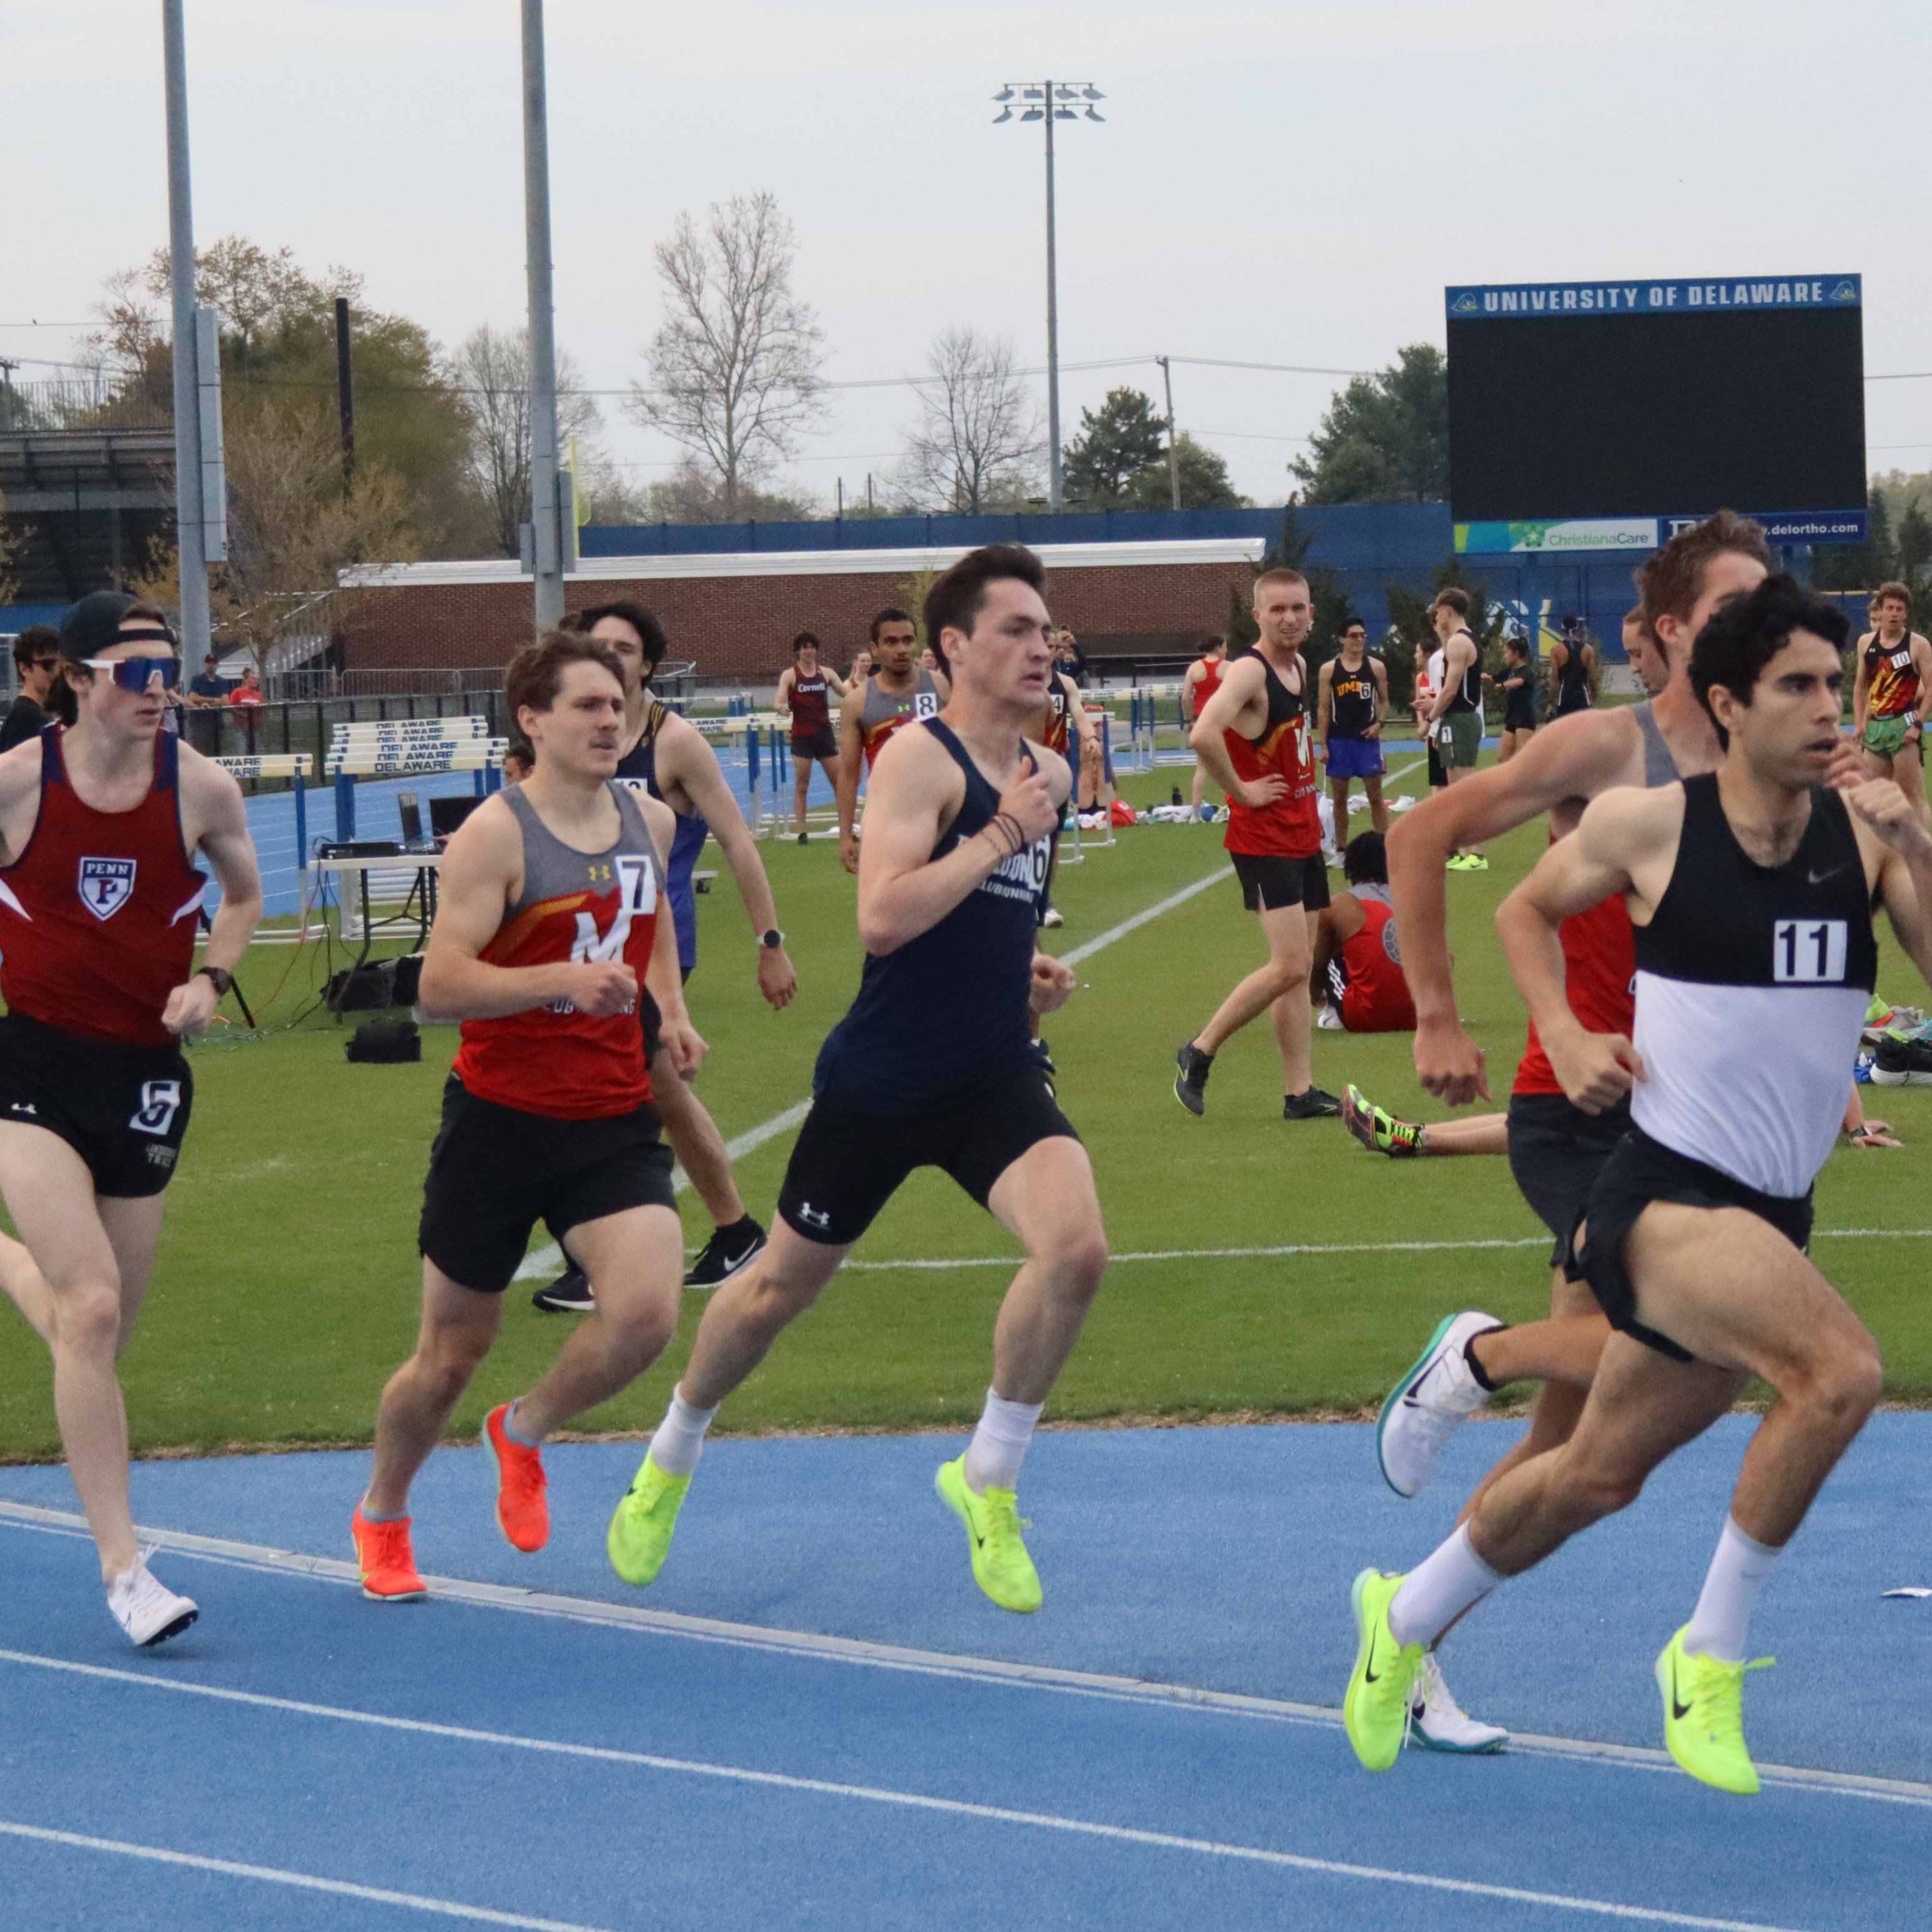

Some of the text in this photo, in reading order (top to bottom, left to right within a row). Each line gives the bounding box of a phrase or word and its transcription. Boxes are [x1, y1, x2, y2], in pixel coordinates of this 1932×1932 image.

[1484, 282, 1822, 312] UNIVERSITY OF DELAWARE
[1549, 533, 1649, 546] ChristianaCare
[1893, 653, 1908, 666] 10
[798, 683, 826, 692] Cornell
[1361, 684, 1369, 697] 6
[919, 695, 934, 716] 8
[375, 760, 452, 772] DELAWARE
[86, 863, 129, 875] PENN
[96, 879, 118, 905] P
[621, 860, 647, 910] 7
[570, 908, 633, 965] M
[1779, 924, 1828, 977] 11
[138, 1082, 172, 1128] 5
